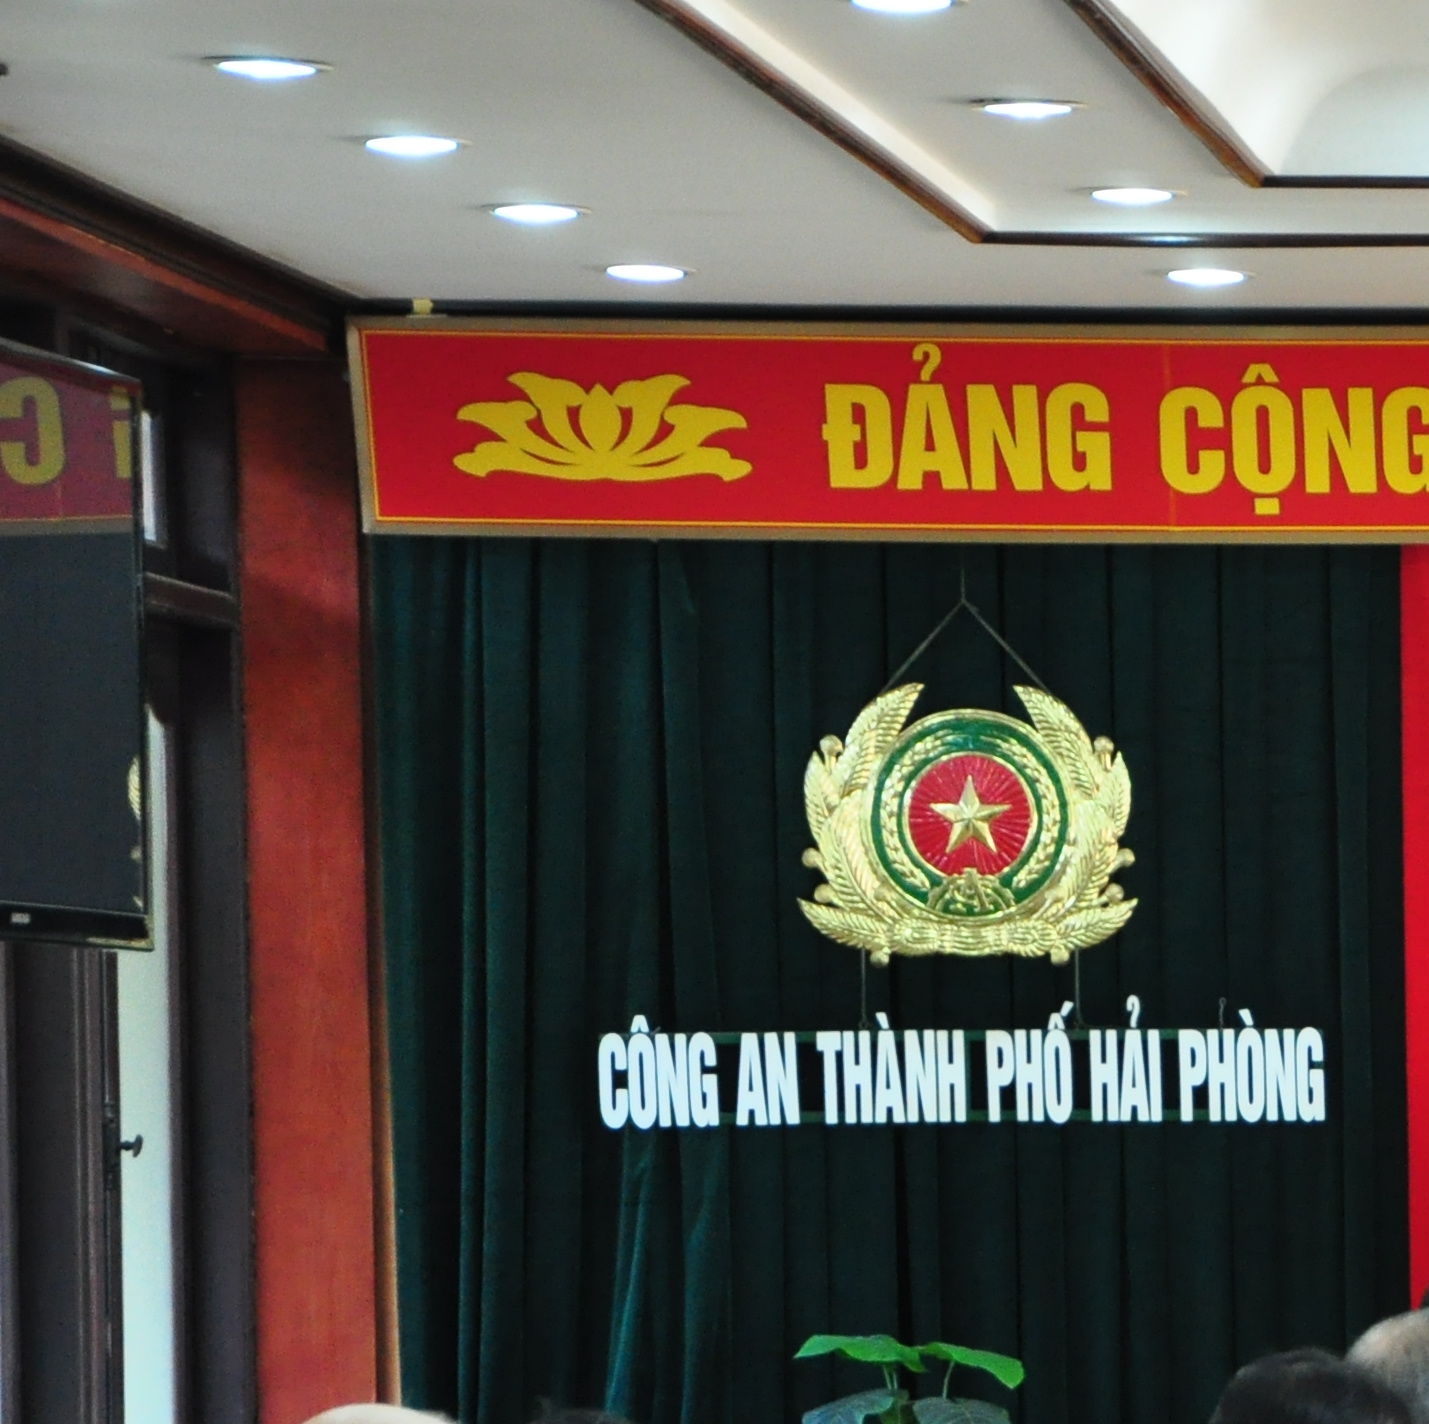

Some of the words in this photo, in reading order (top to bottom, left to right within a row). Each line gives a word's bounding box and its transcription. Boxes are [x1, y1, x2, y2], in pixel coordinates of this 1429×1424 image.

[823, 344, 1111, 491] ĐẢNG
[599, 1015, 719, 1129] CÔNG
[736, 1032, 800, 1127] AN
[816, 1012, 966, 1124] THÀNH
[986, 1001, 1073, 1123] PHỐ
[1089, 995, 1162, 1122] HẢI
[1178, 1009, 1325, 1122] PHÒNG
